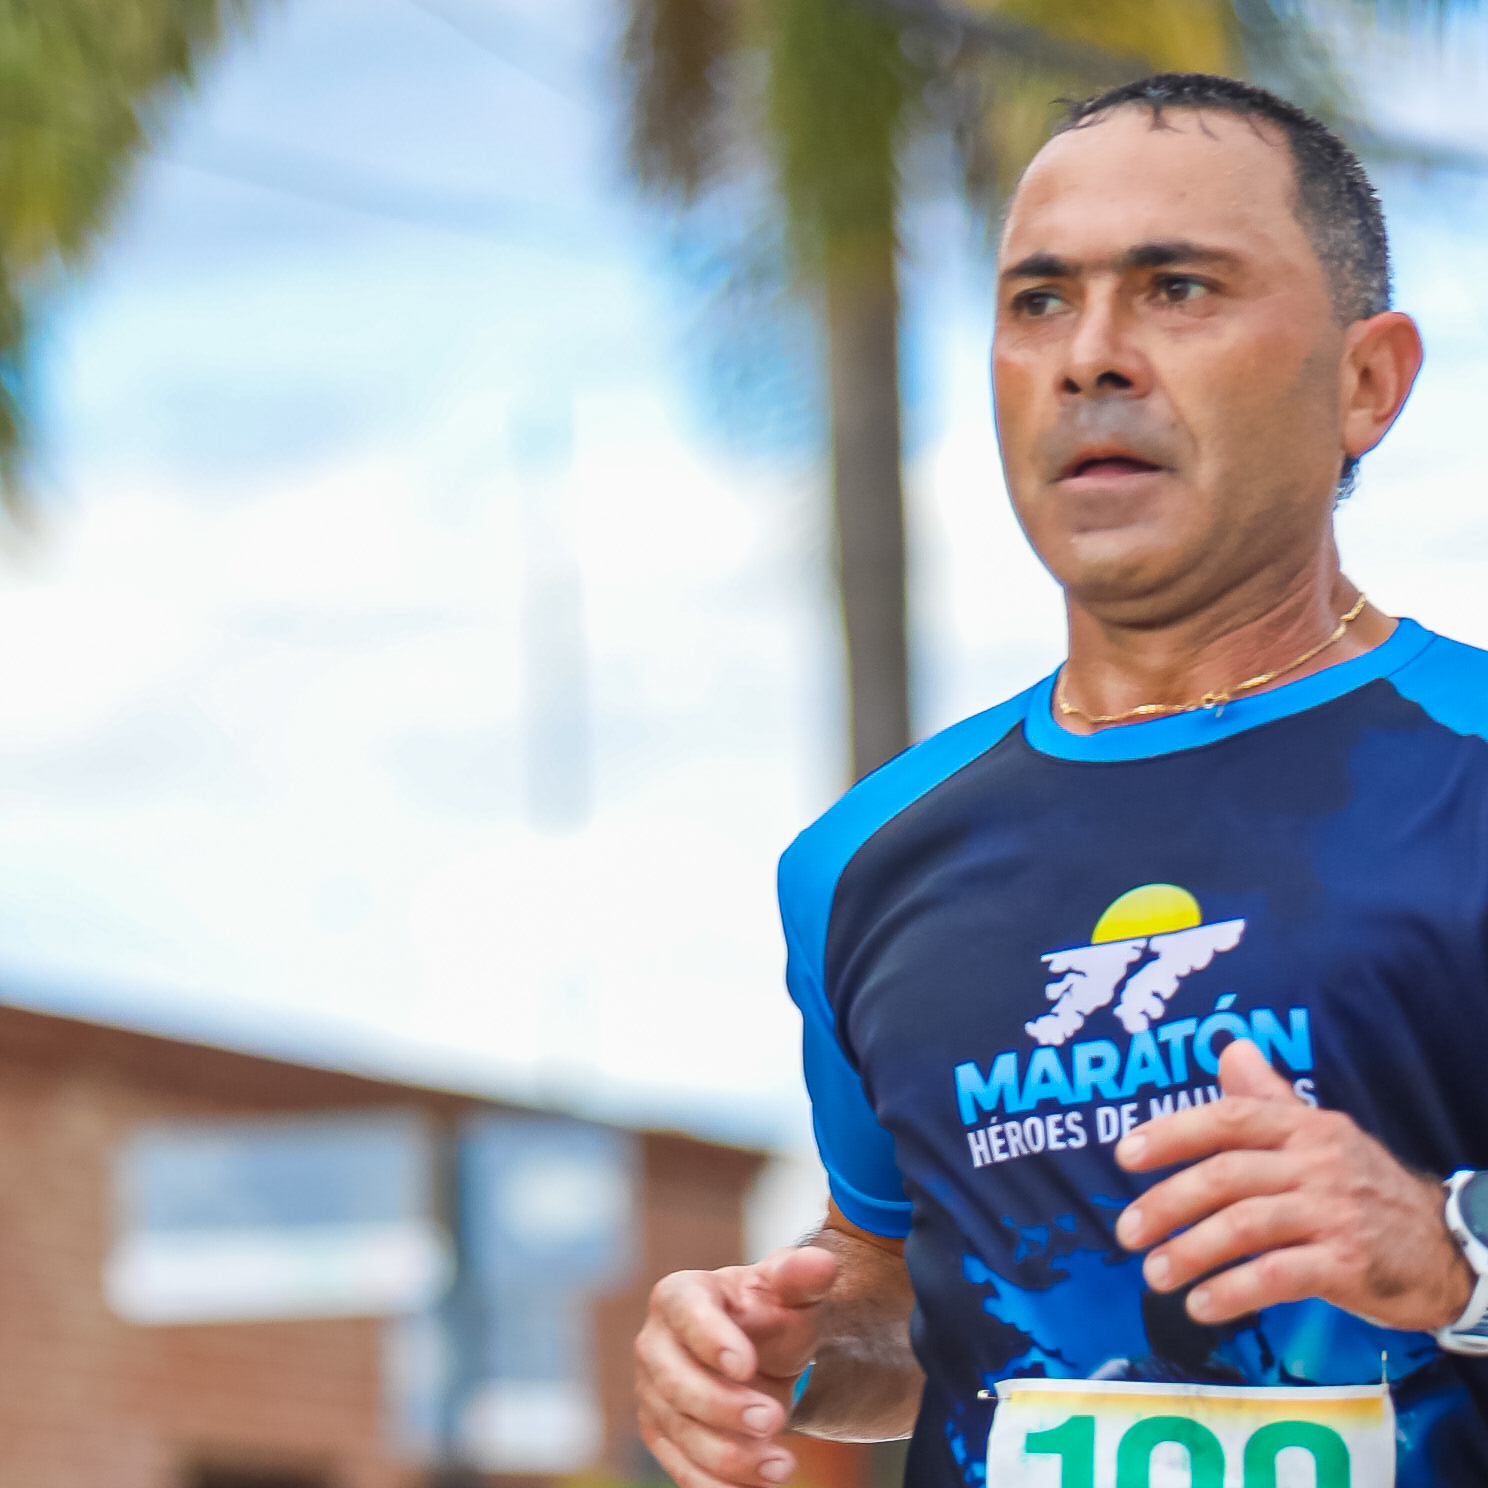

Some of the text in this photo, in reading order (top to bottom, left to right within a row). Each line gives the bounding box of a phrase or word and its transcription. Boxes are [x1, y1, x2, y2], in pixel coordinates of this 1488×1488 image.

[954, 993, 1314, 1125] MARATÓN
[965, 1101, 1139, 1168] HÉROES DE
